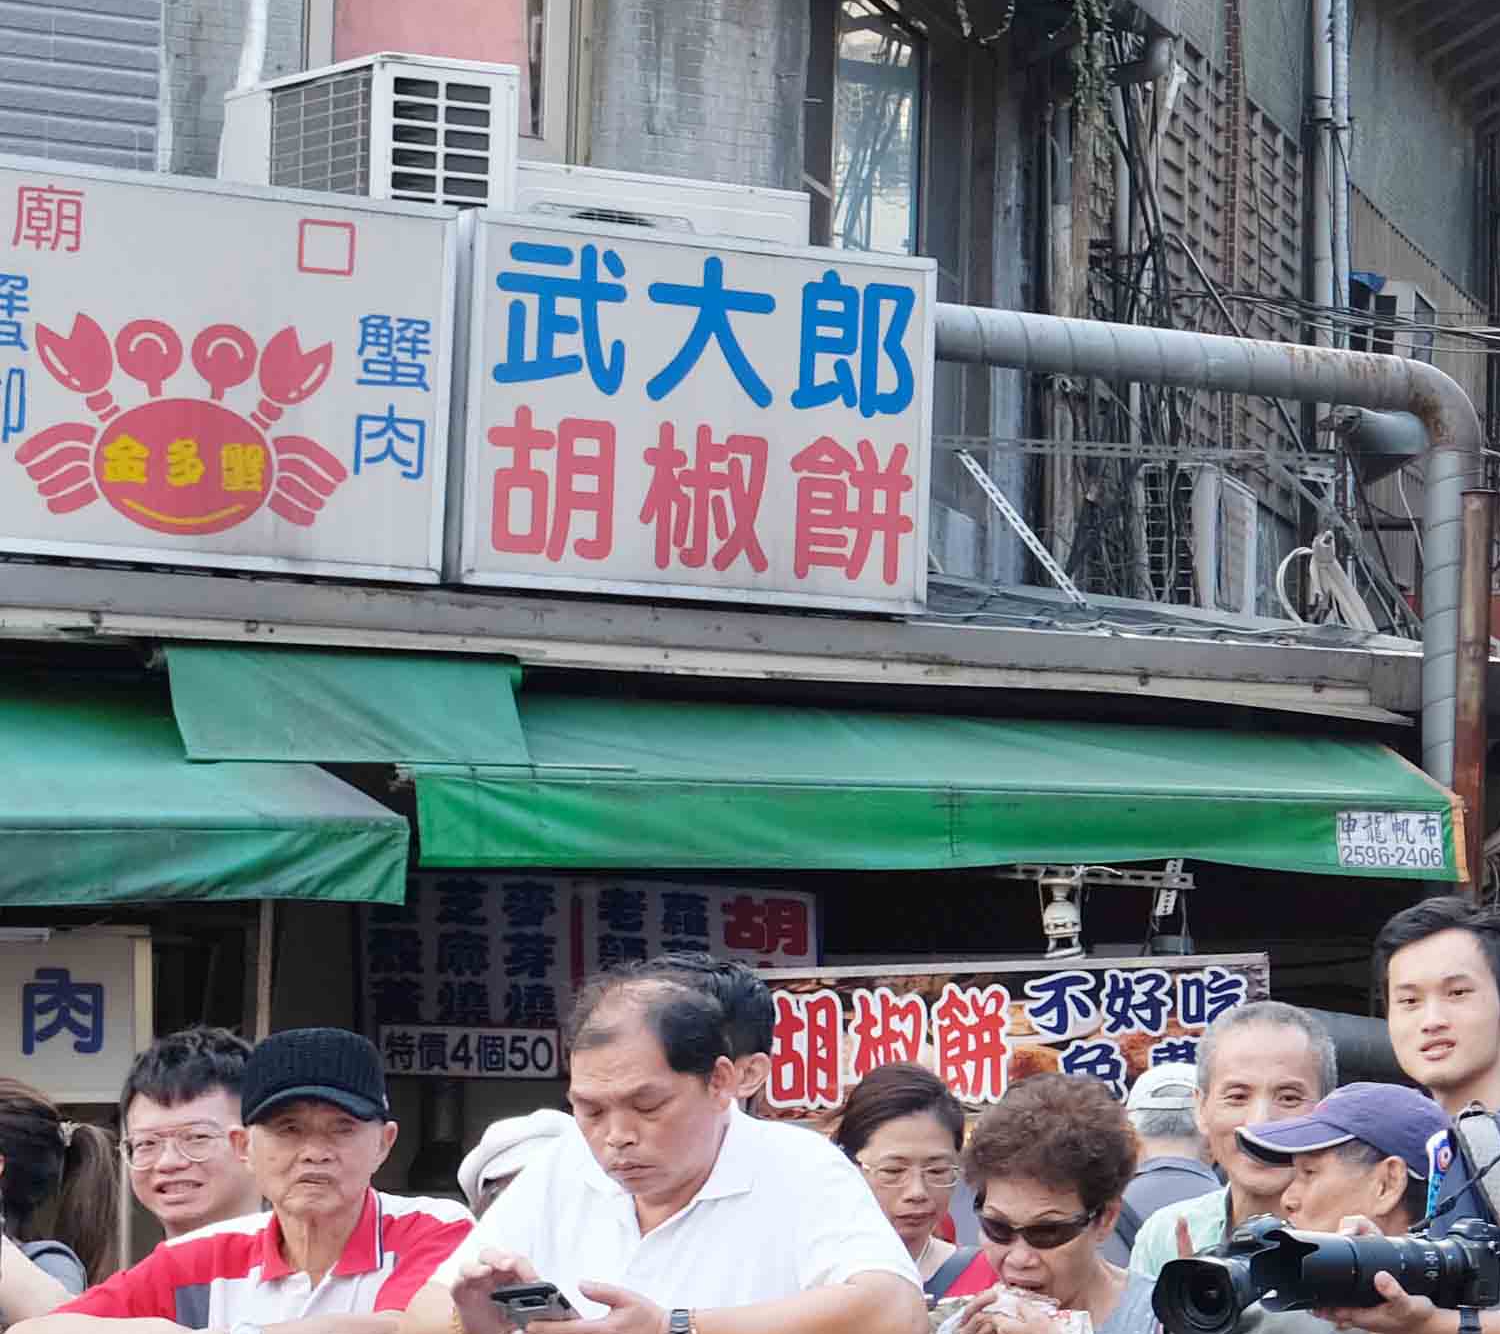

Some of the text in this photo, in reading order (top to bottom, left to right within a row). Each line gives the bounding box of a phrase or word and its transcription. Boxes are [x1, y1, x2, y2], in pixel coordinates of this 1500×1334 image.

[353, 313, 432, 481] 蟹肉
[492, 240, 916, 419] 武大郎
[487, 404, 915, 587] 胡椒餅
[22, 967, 105, 1055] 肉
[384, 1031, 557, 1073] 特價4個50
[774, 985, 1006, 1104] 胡椒餅
